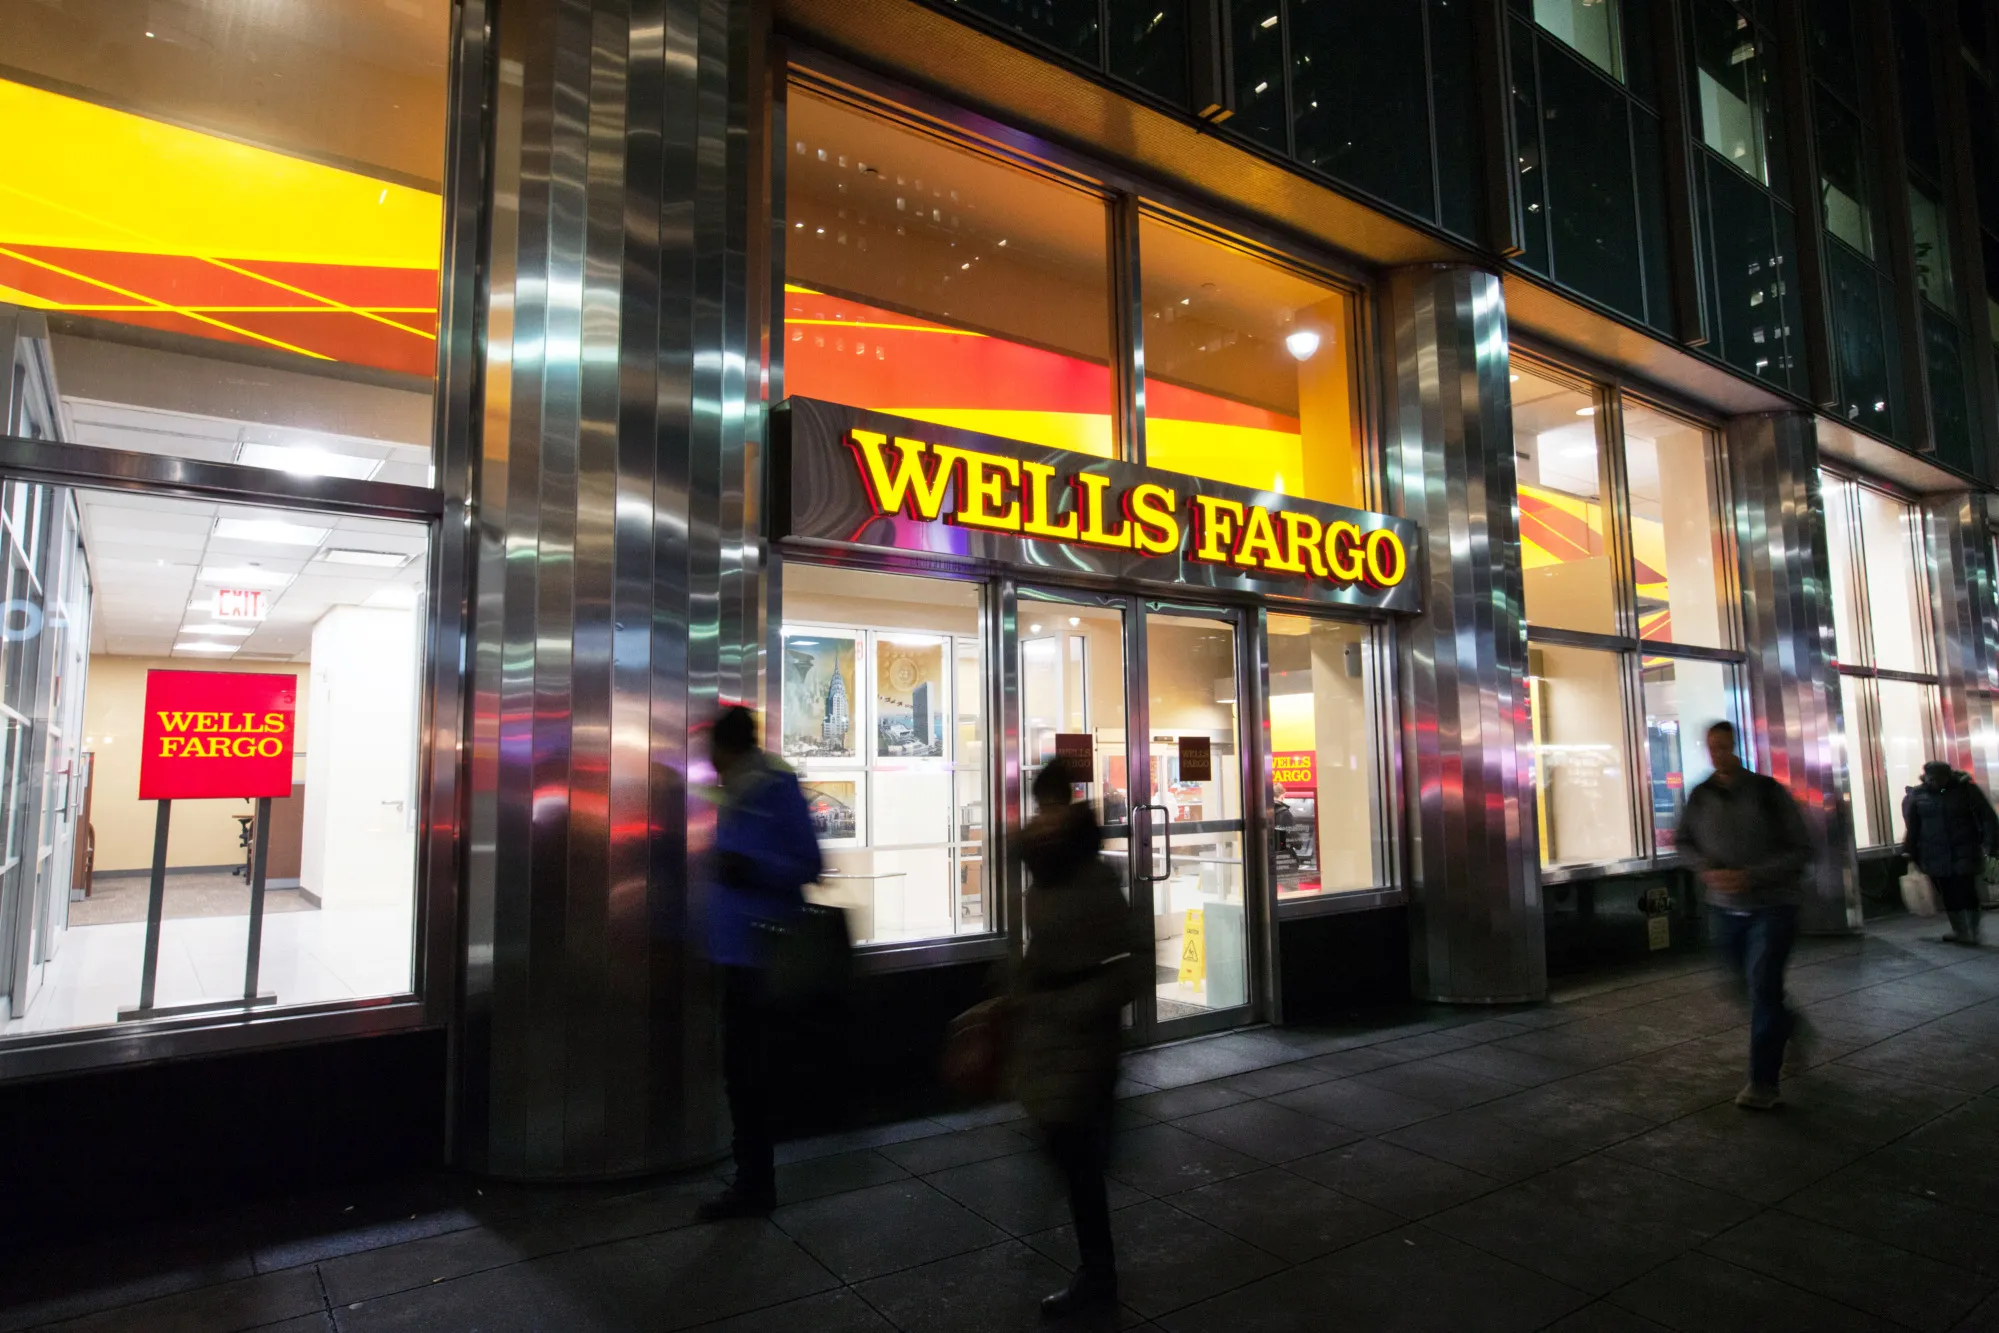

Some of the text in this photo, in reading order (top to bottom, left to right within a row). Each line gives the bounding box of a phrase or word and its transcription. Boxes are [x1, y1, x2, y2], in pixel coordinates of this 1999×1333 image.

[851, 429, 1406, 587] WELLS FARGO
[219, 590, 261, 617] EXIT
[157, 711, 285, 733] WELLS
[159, 737, 282, 757] FARGO
[1182, 750, 1210, 758] WELLS
[1182, 759, 1210, 768] FARGO
[1272, 770, 1312, 782] ARGO
